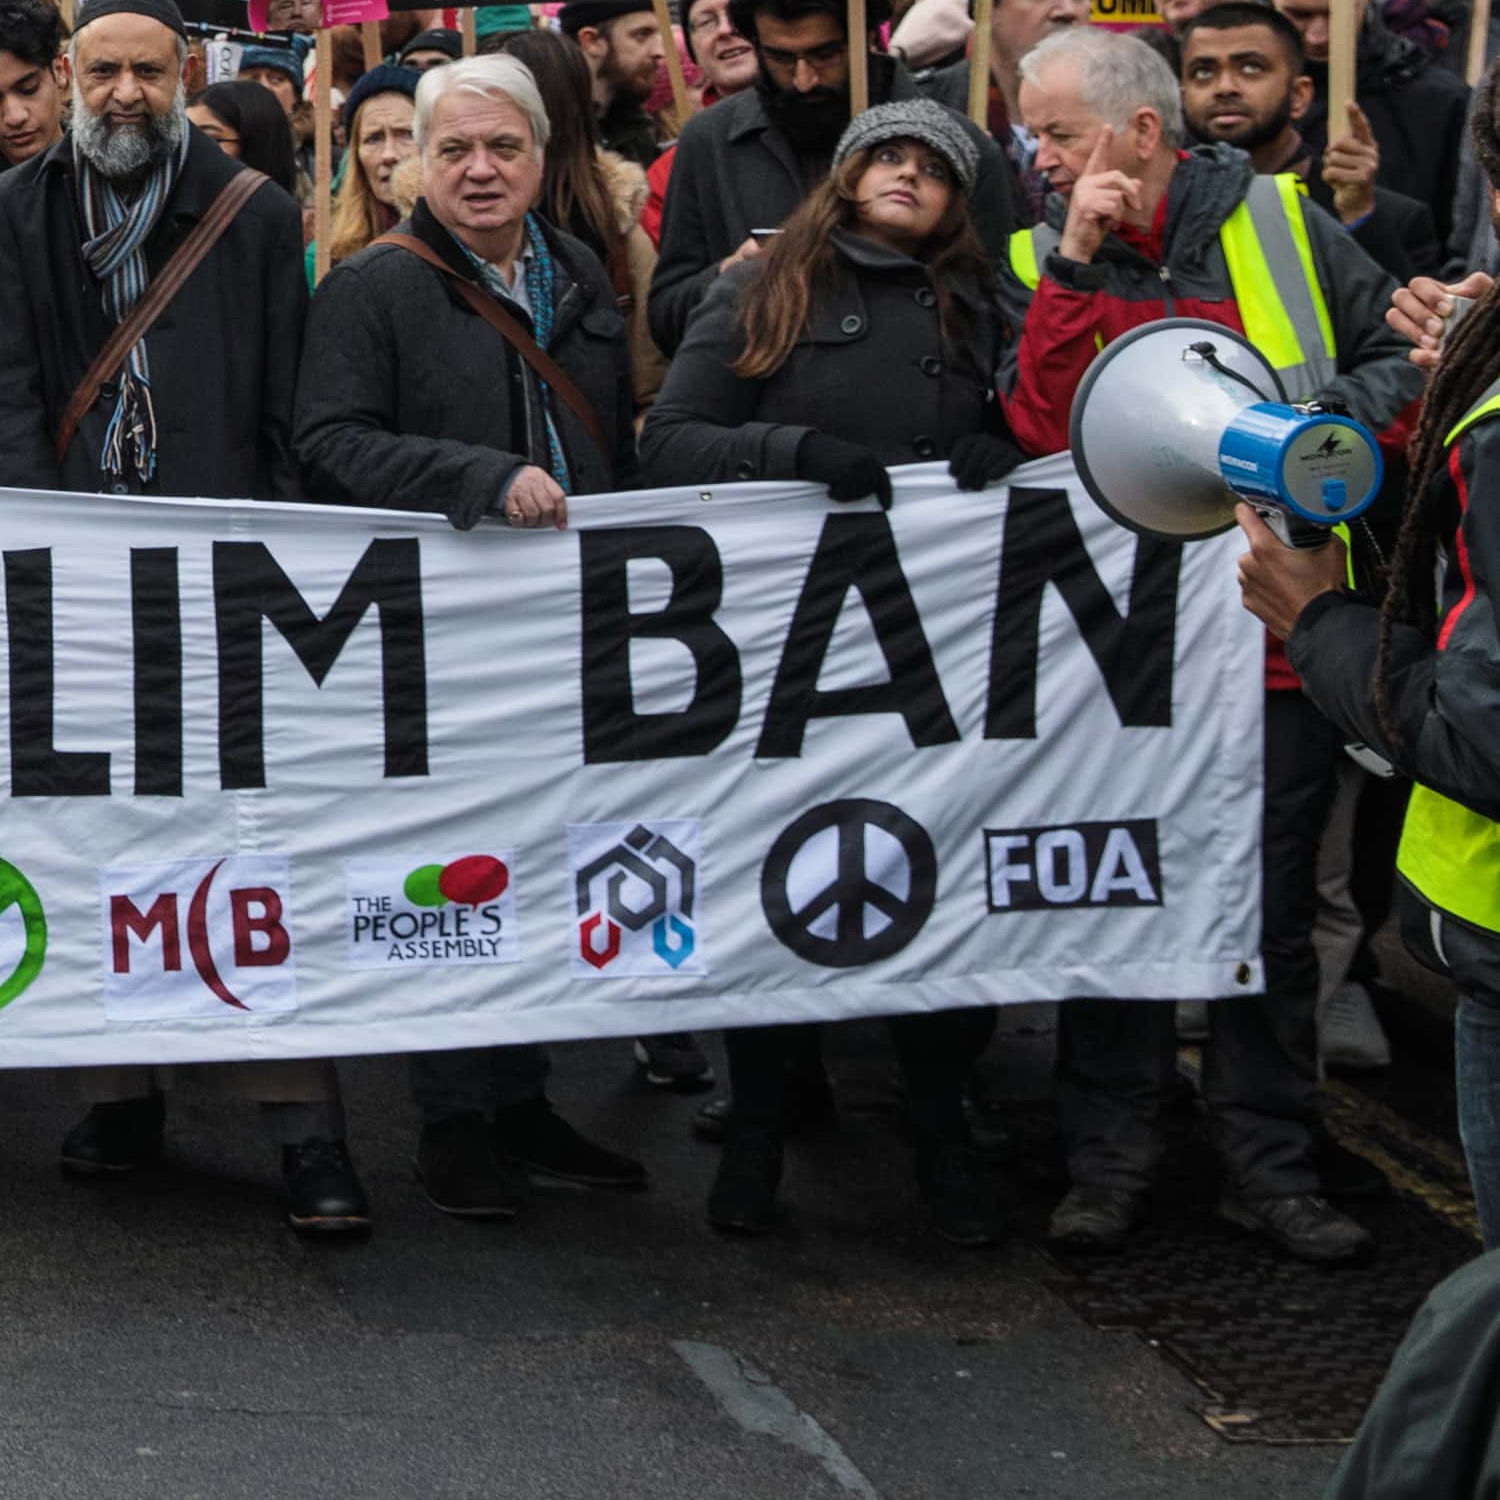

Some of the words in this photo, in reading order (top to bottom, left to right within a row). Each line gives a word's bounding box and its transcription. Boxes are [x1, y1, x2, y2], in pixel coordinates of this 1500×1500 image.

[580, 482, 1181, 765] BAN
[987, 828, 1158, 907] FOA
[352, 896, 393, 913] THE
[352, 904, 502, 943] PEOPLE'S
[387, 935, 502, 961] ASSEMBLY
